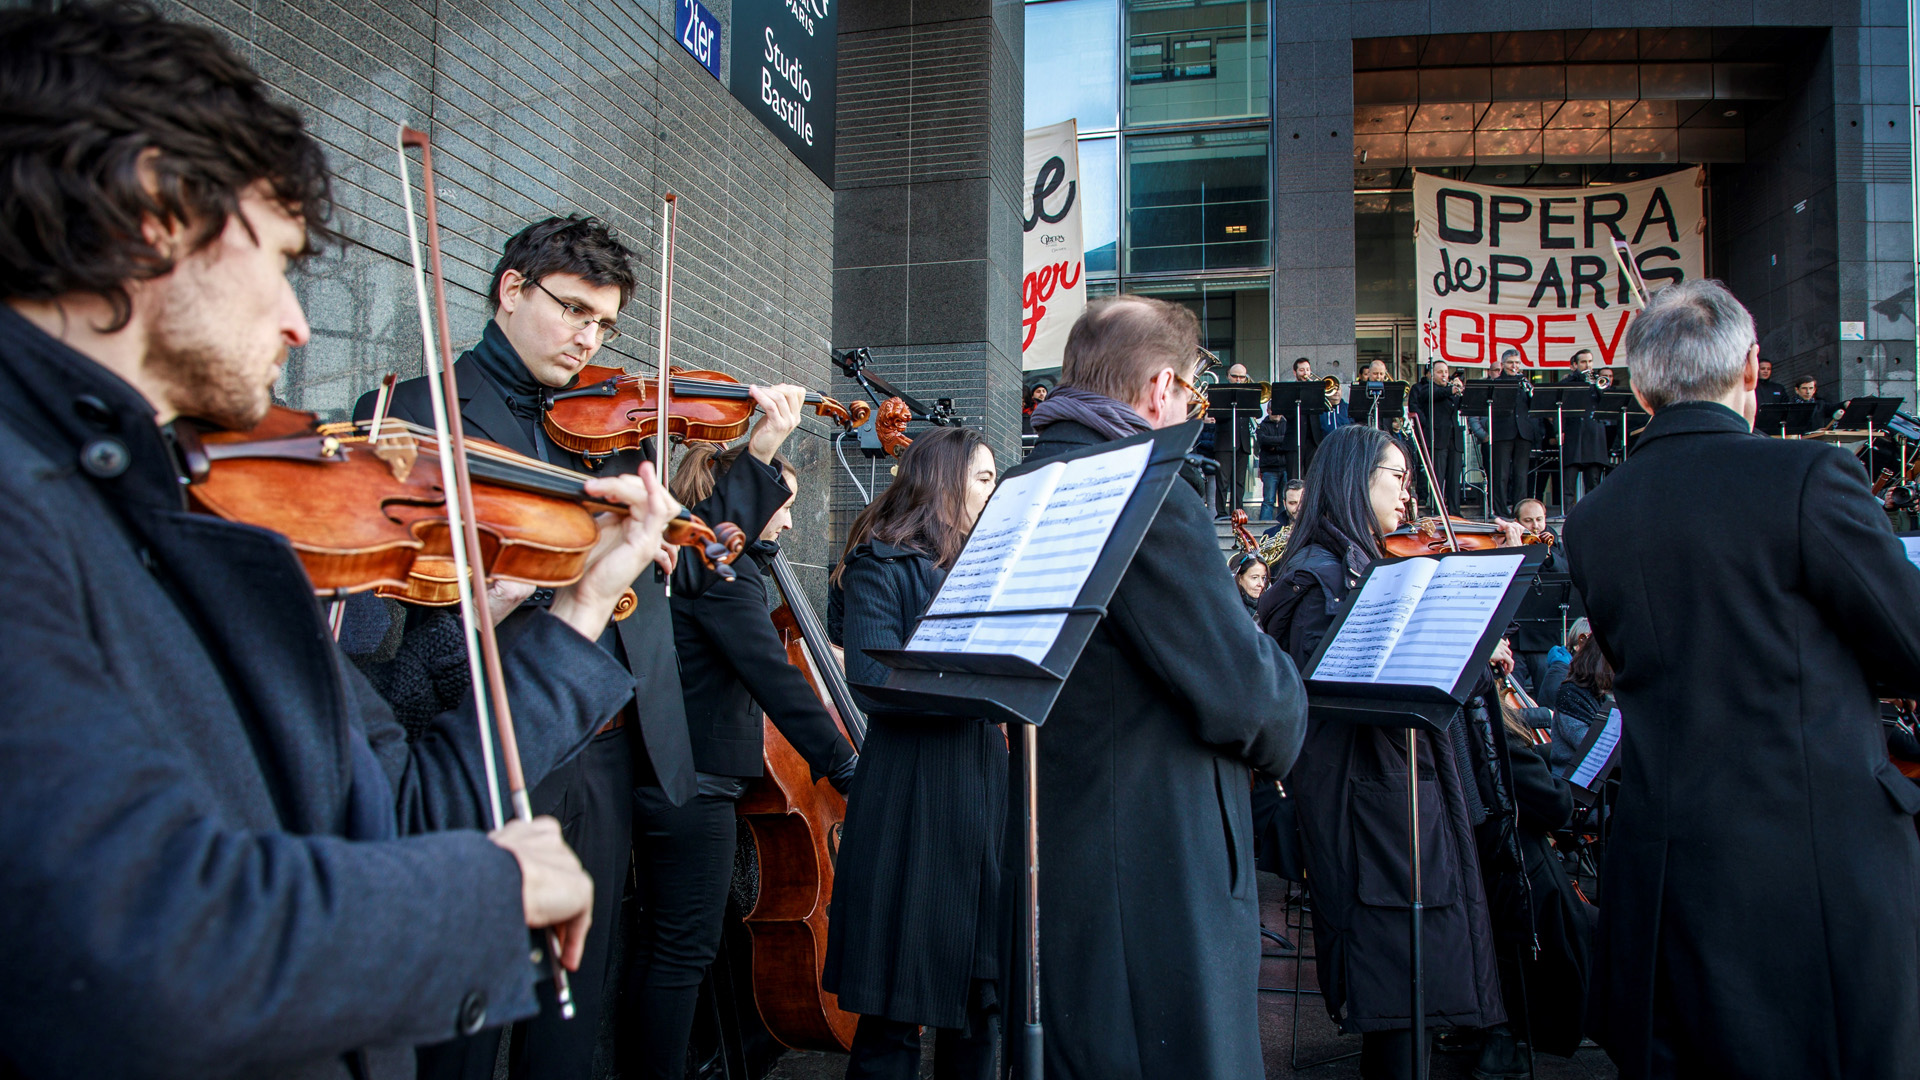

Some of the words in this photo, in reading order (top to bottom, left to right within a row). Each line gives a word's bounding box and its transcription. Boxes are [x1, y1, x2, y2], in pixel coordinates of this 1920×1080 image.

[683, 0, 715, 67] 2ter
[764, 26, 812, 102] Studio
[761, 66, 813, 147] Bastille
[1436, 187, 1680, 249] OPERA
[1433, 248, 1487, 297] de
[1488, 246, 1685, 309] PARIS
[1439, 308, 1642, 368] GREV
